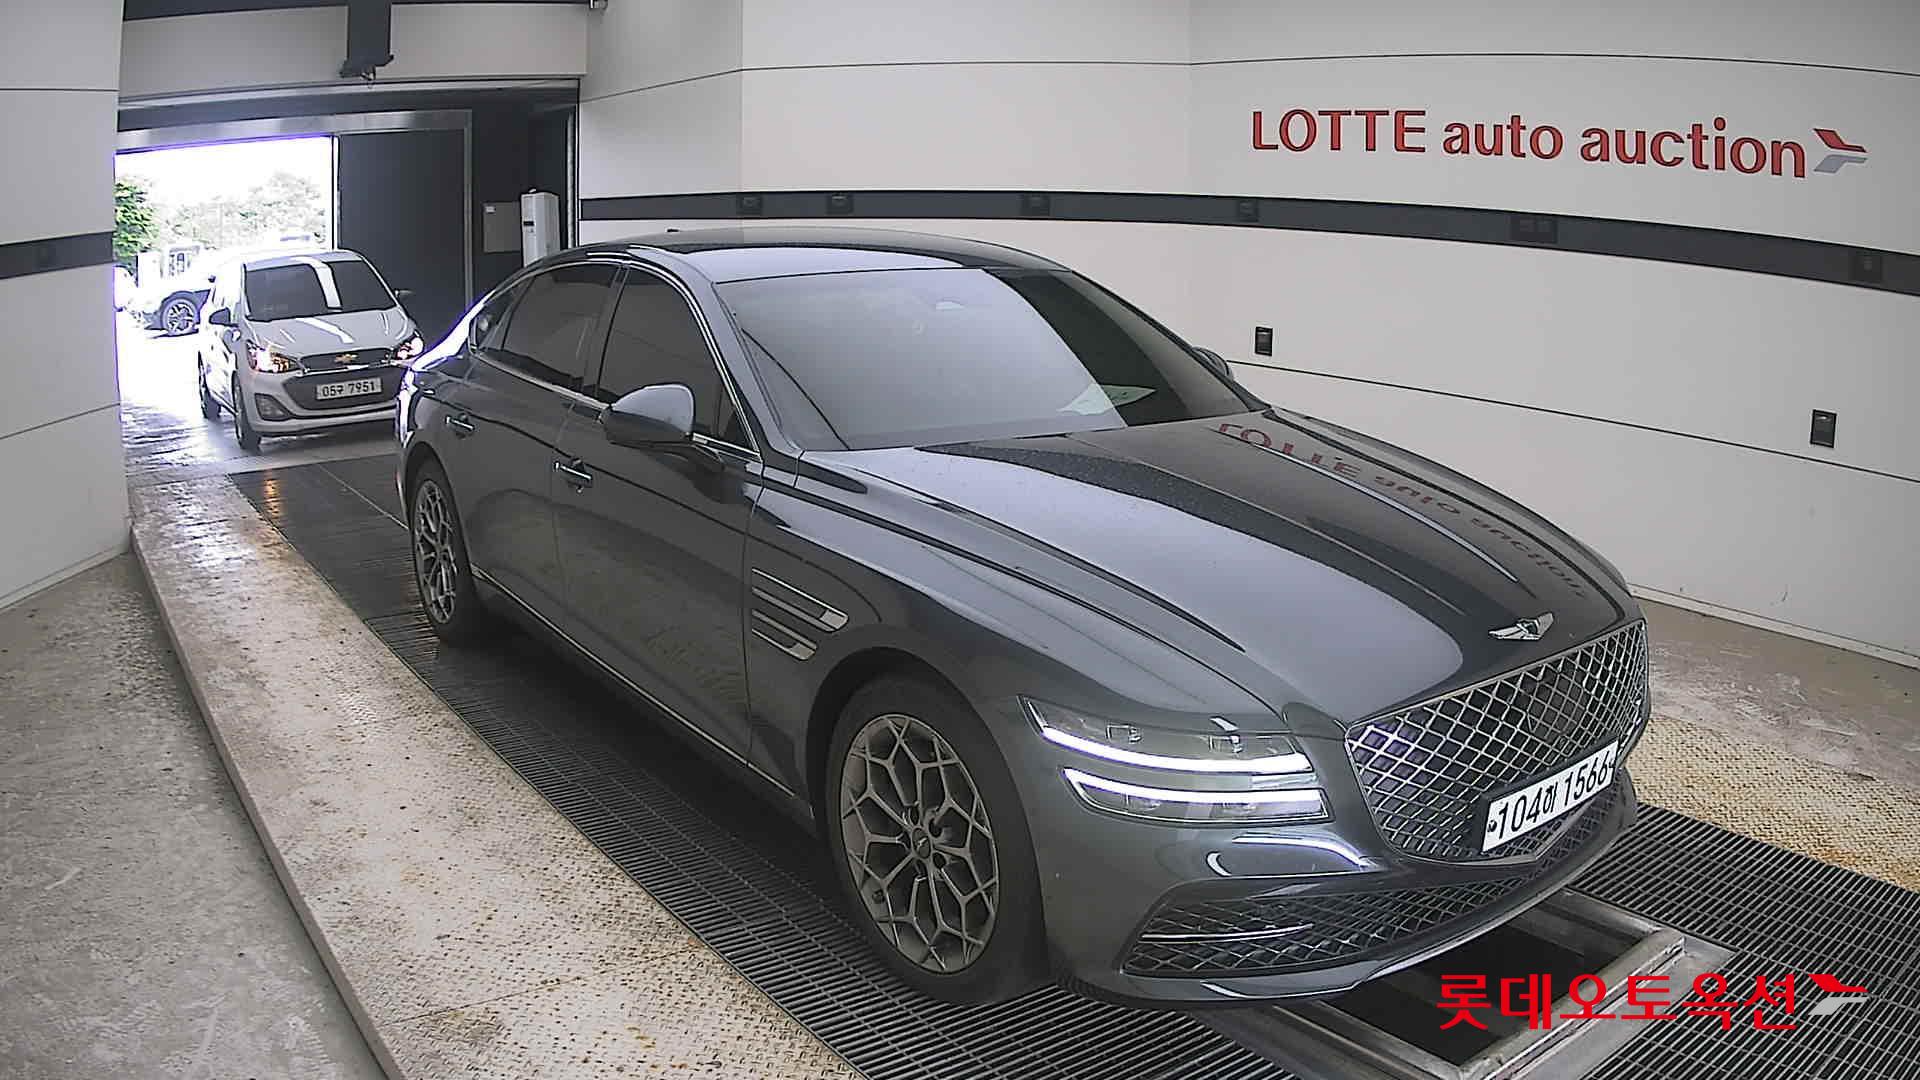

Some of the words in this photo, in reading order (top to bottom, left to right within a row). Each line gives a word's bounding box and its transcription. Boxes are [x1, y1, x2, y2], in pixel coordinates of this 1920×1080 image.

[1251, 109, 1427, 153] LOTTE
[1443, 114, 1564, 160] auto
[1580, 117, 1807, 179] auction
[348, 381, 375, 394] 7951
[1565, 750, 1610, 806] 1566
